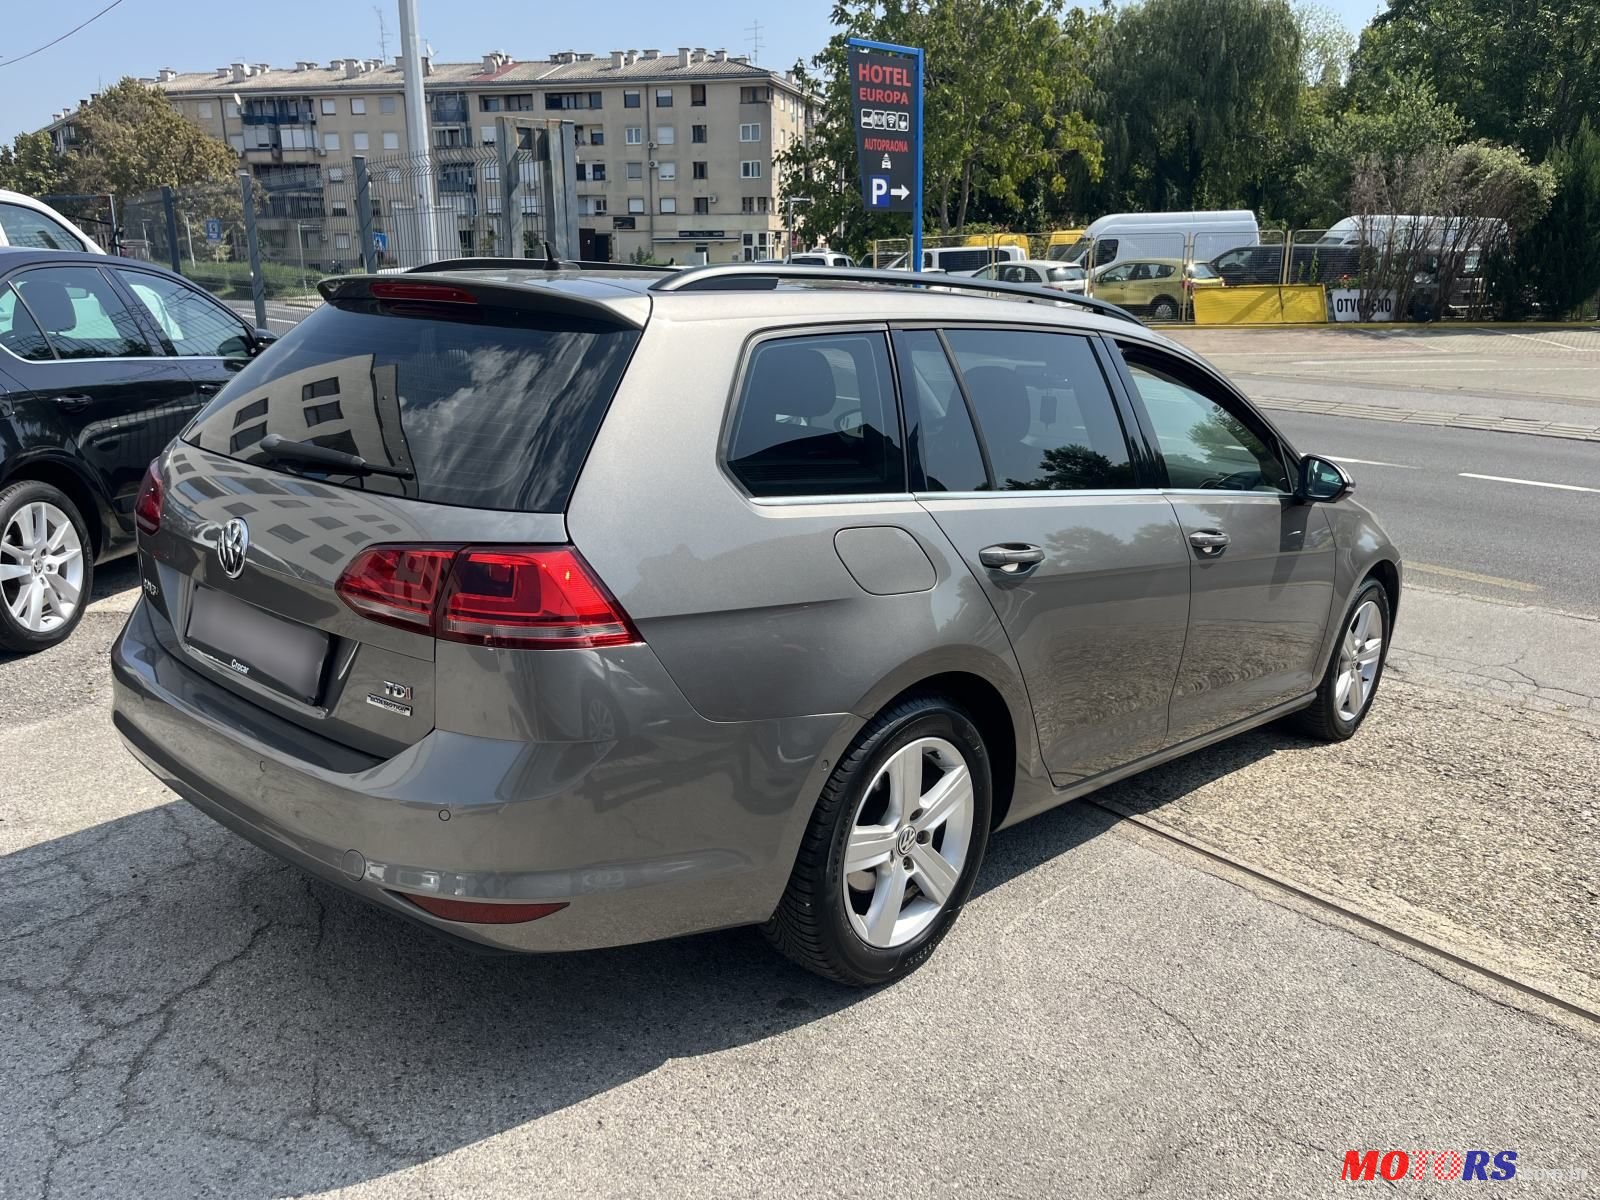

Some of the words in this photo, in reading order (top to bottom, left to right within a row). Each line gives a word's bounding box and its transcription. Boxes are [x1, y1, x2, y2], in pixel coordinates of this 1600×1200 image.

[858, 63, 912, 87] HOTEL
[859, 87, 909, 105] EUROPA
[864, 137, 908, 153] AUTOPRAONA
[871, 178, 888, 205] P
[1336, 298, 1392, 313] OTVENO
